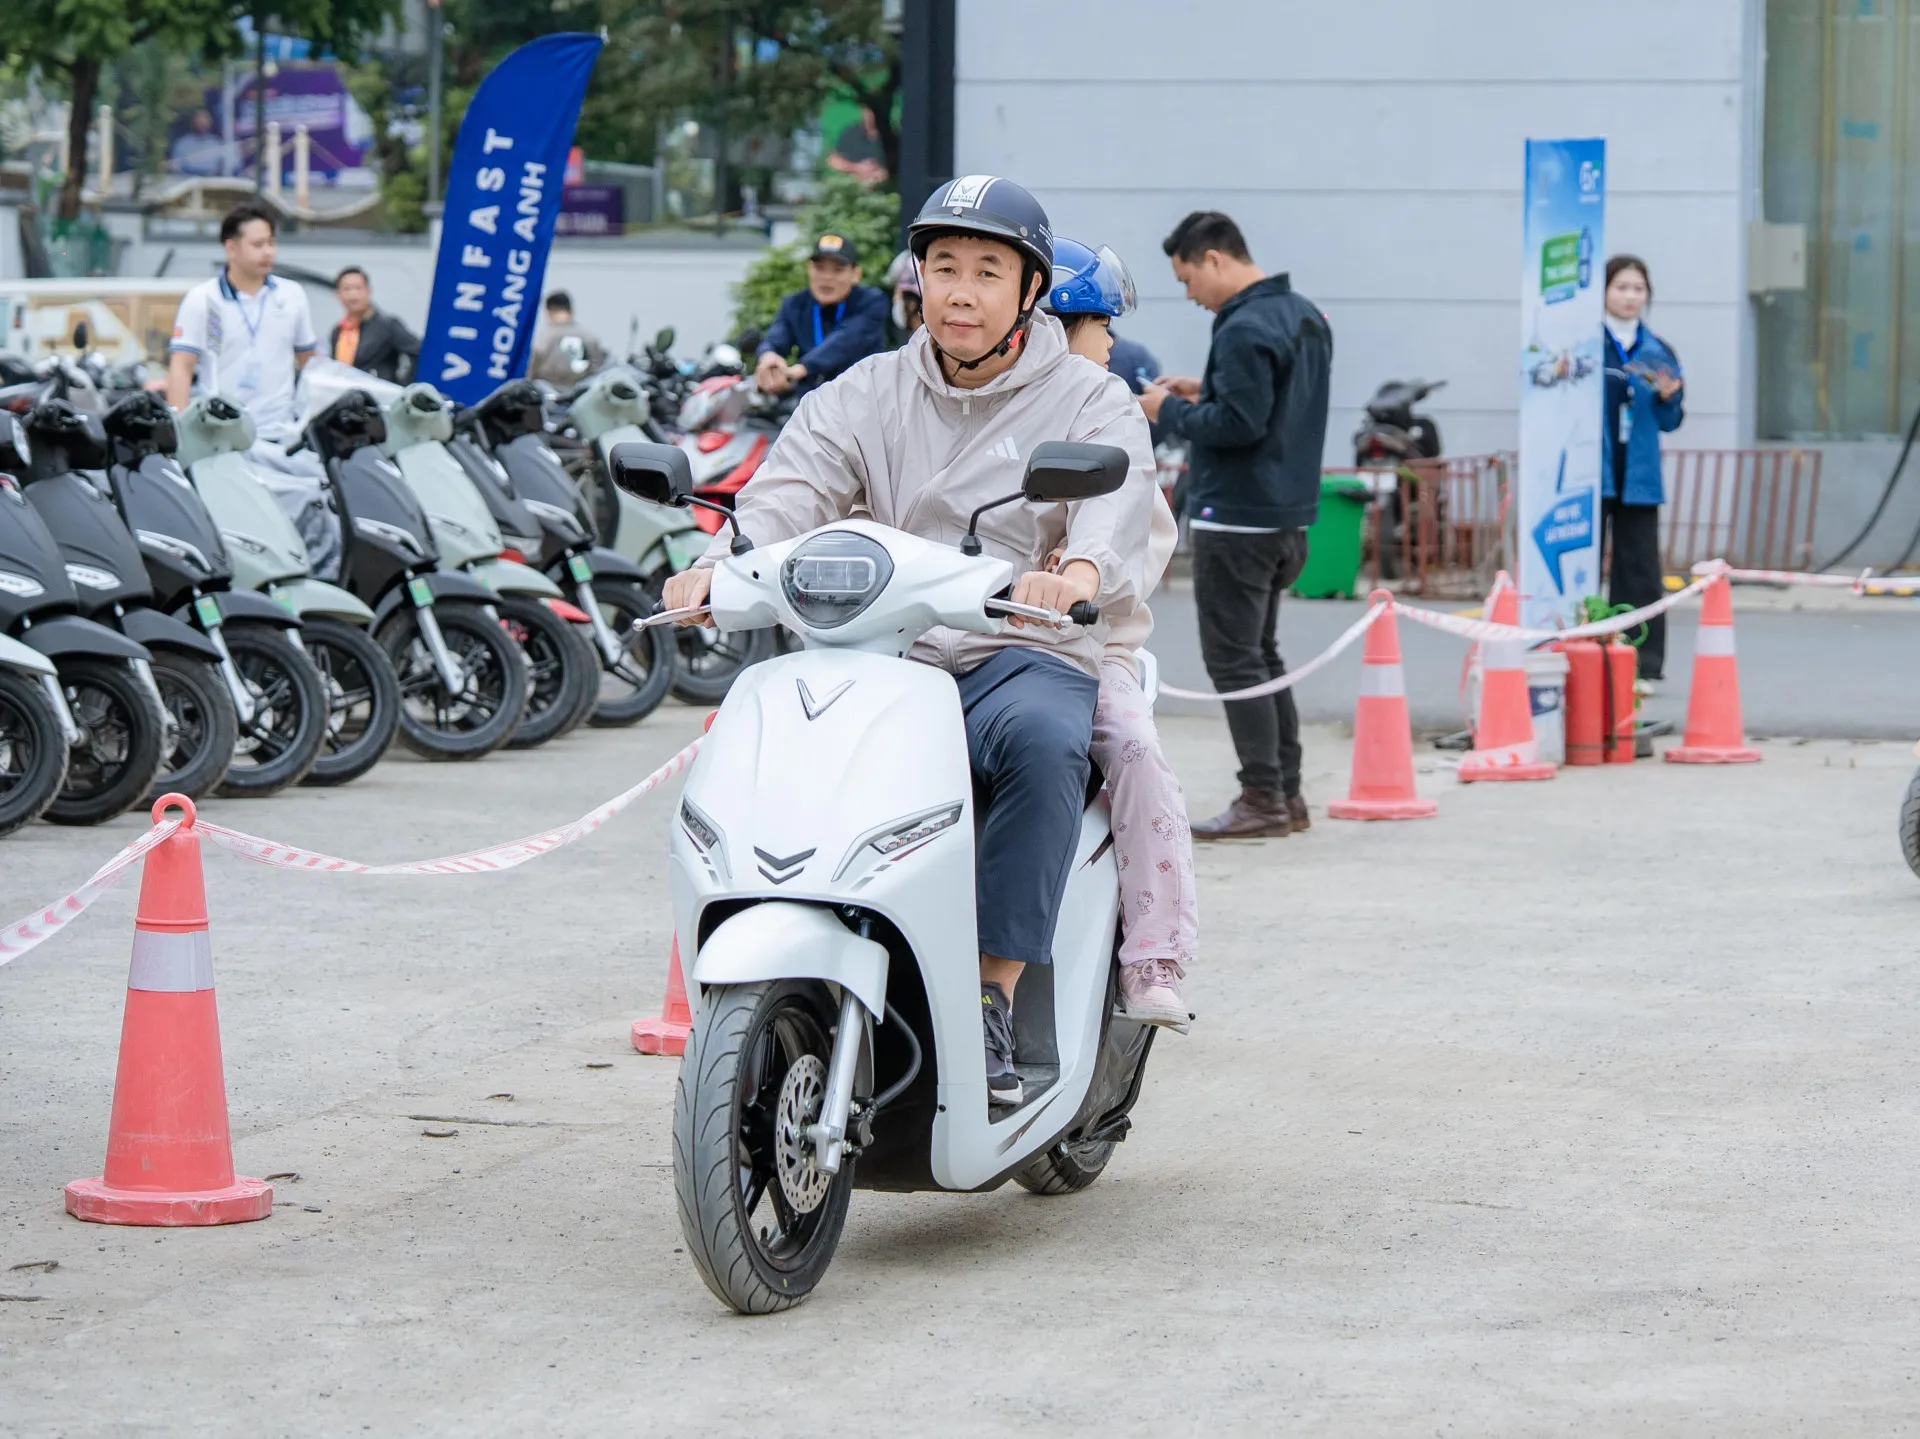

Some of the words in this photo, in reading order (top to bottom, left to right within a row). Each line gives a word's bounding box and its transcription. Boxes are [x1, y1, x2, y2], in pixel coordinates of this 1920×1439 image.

[443, 128, 513, 381] VINFAST
[487, 249, 532, 379] HOÀNG
[514, 162, 546, 241] ANH
